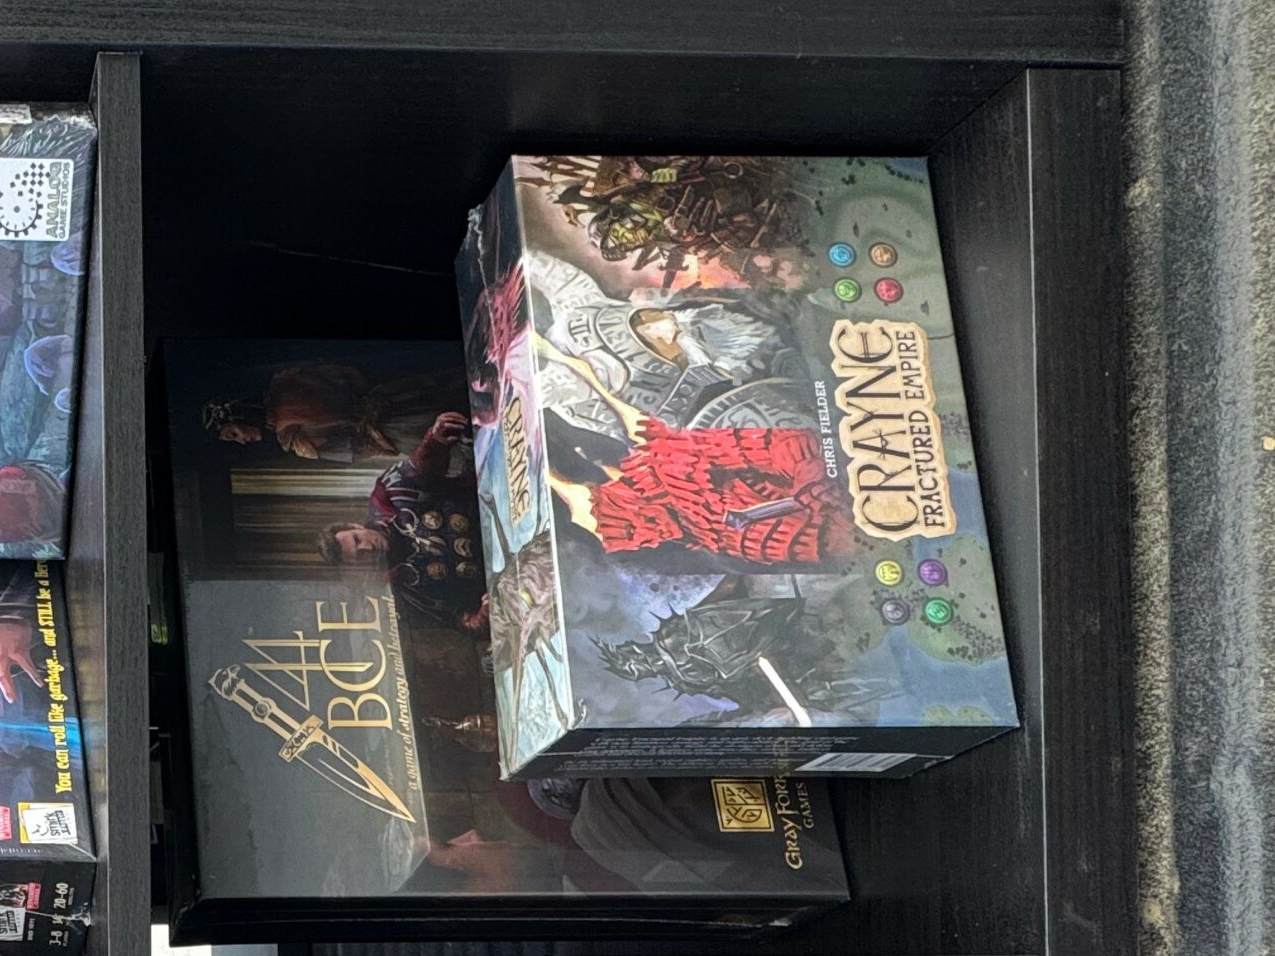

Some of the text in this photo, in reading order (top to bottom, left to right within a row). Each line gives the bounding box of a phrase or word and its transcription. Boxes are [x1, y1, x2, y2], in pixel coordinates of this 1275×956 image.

[45, 162, 62, 238] ANALOG
[59, 161, 70, 239] GAME STUDIOS
[814, 380, 838, 478] CHRIS FIELDER
[837, 326, 919, 532] CRAYNE
[895, 330, 945, 528] FRACTURED EMPIRE
[36, 588, 51, 600] be
[36, 602, 55, 626] STILL
[39, 628, 57, 646] and
[44, 649, 69, 700] garbage...
[316, 596, 393, 730] BCE
[389, 652, 404, 675] and
[47, 704, 65, 722] like
[395, 678, 410, 730] strategy
[49, 726, 67, 746] roll
[397, 729, 413, 744] of
[55, 749, 70, 769] can
[405, 746, 418, 779] game
[55, 772, 72, 794] You
[409, 782, 419, 790] a
[795, 782, 815, 828] GAMES
[53, 882, 69, 908] 20-60
[49, 930, 63, 946] 3-8
